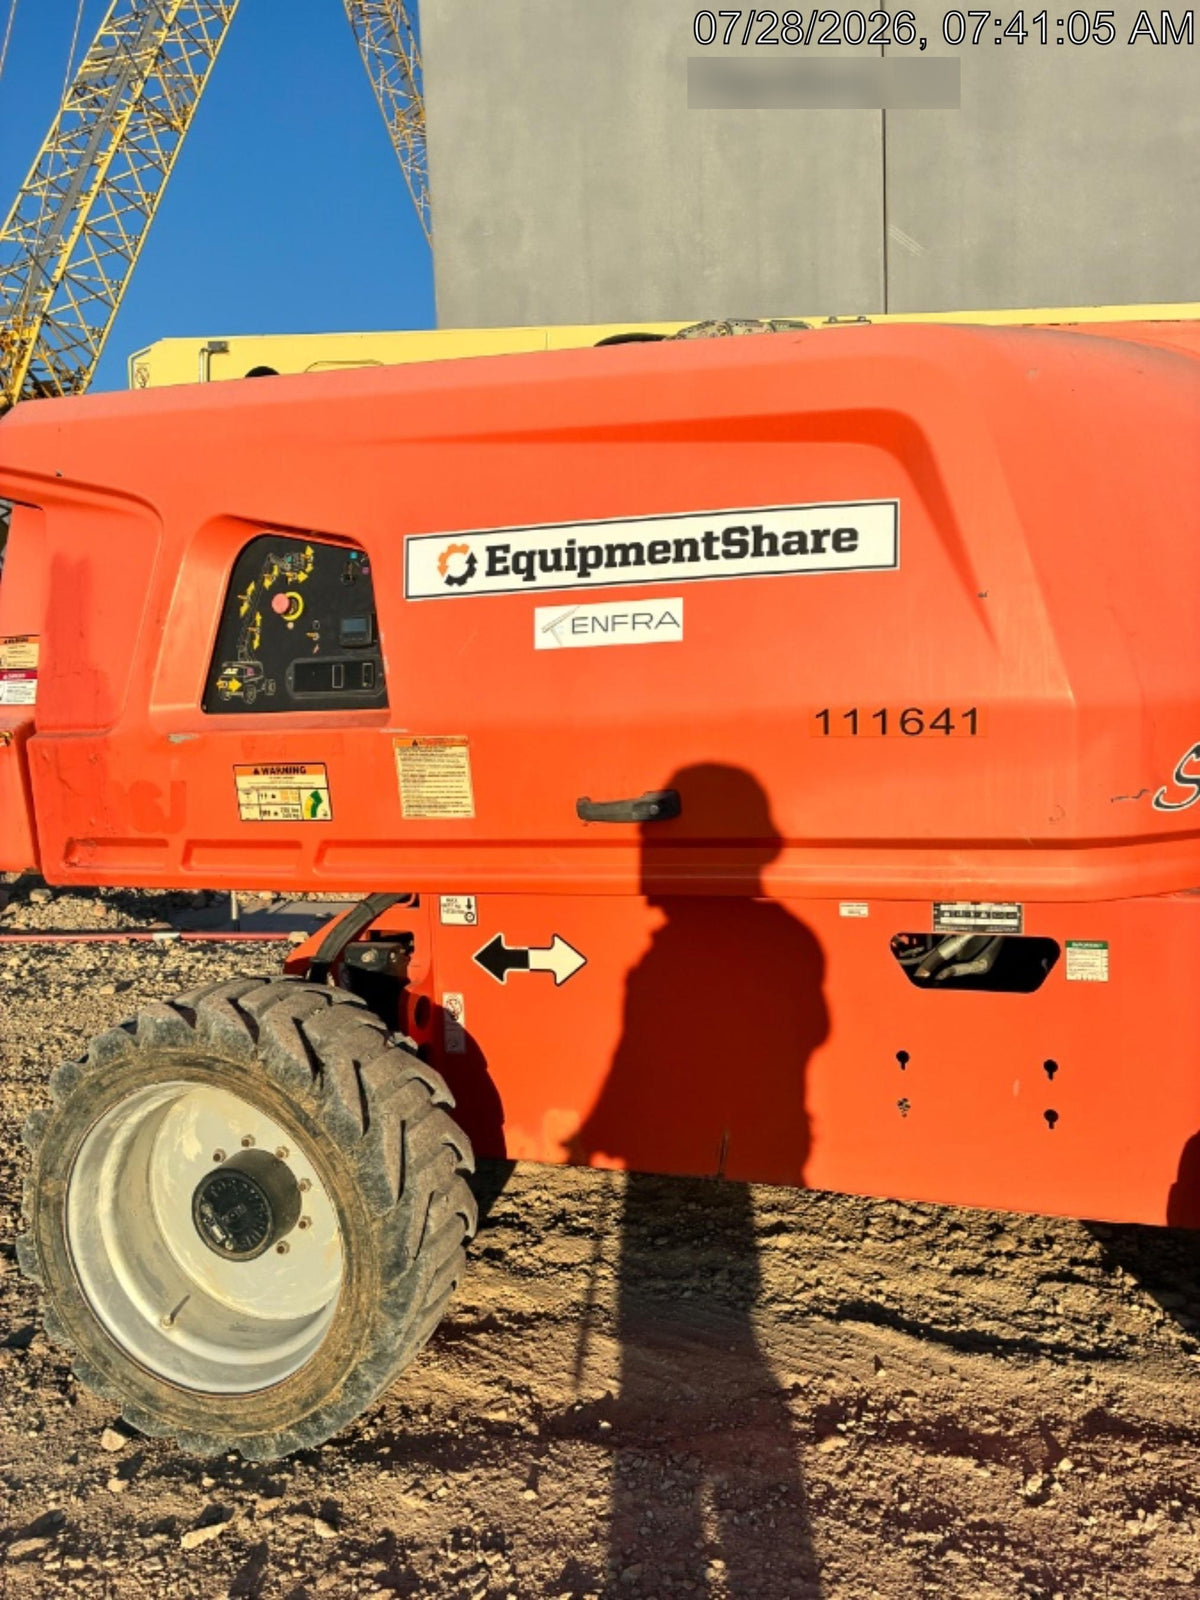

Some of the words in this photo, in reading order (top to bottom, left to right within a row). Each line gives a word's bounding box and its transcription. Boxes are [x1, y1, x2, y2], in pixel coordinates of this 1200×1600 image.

[485, 524, 859, 582] EquipmentShare
[571, 611, 681, 635] ENFRA
[815, 707, 977, 736] 111641
[262, 766, 306, 775] WARNING
